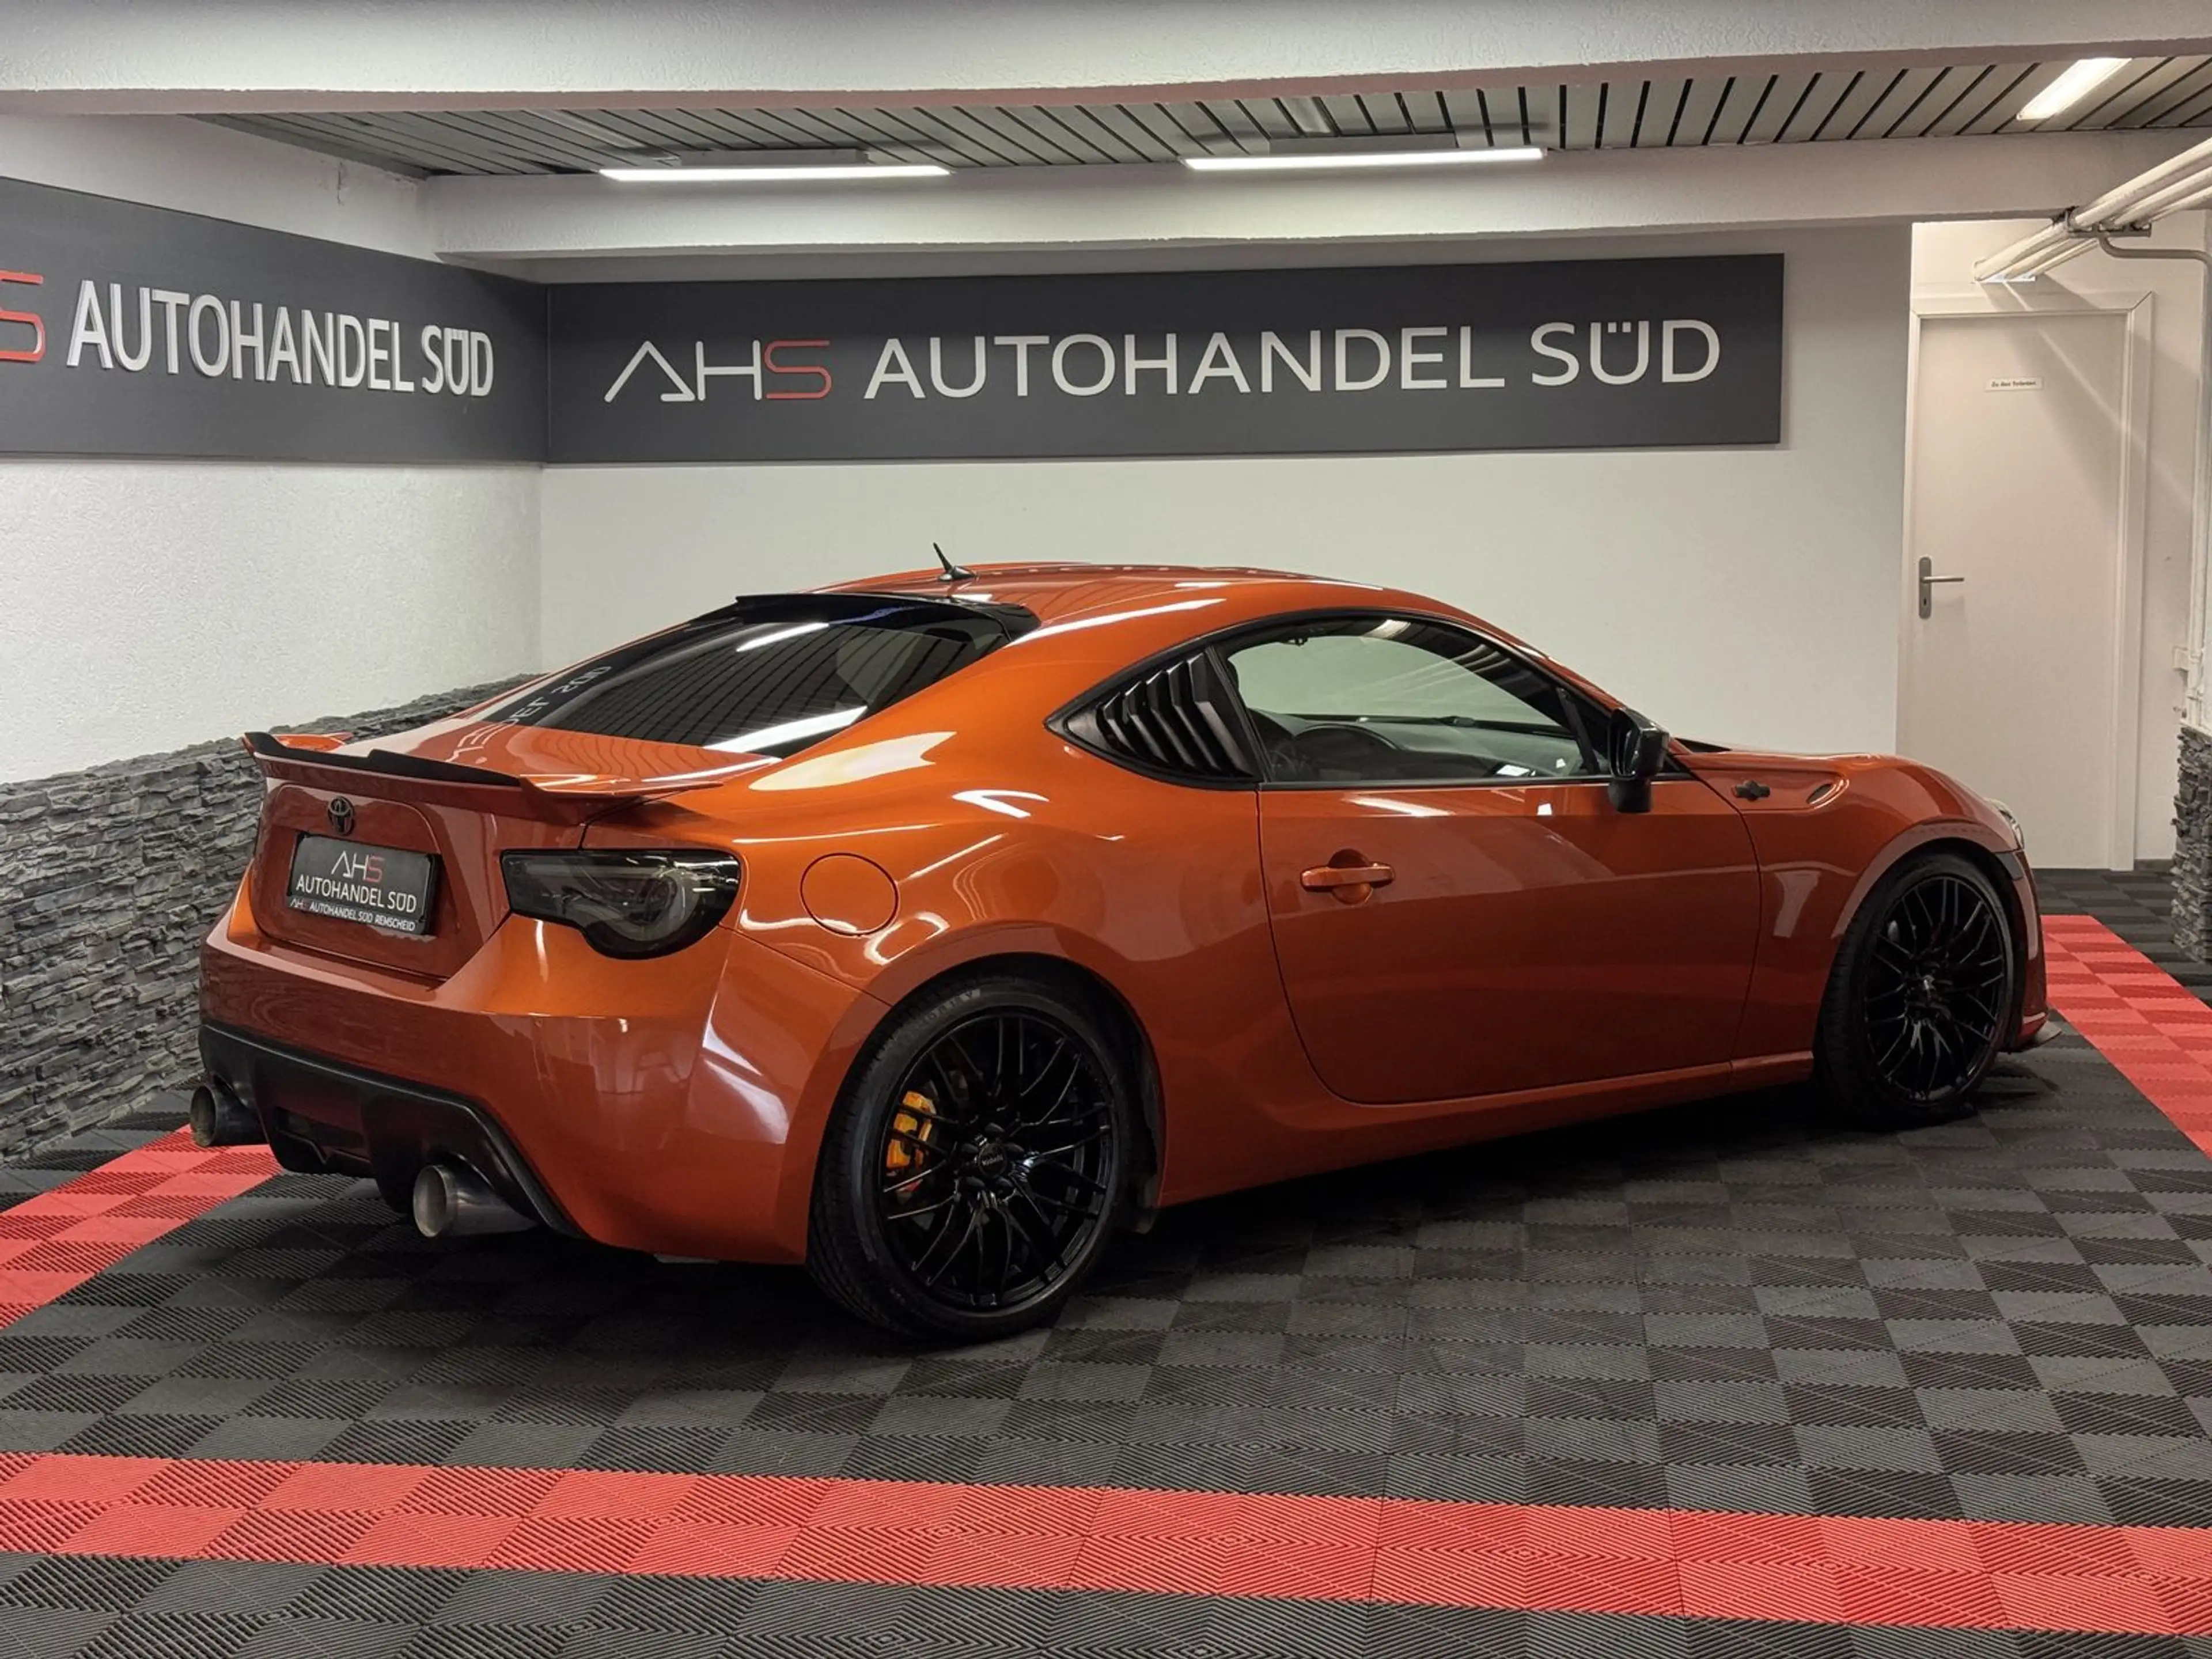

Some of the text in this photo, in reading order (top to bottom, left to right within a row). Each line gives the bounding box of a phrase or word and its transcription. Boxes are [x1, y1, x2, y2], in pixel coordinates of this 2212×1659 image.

[66, 280, 414, 393] AUTOHANDEL
[421, 325, 494, 397] SÜD
[604, 319, 1721, 402] AHS AUTOHANDEL SÜD
[331, 850, 385, 883] AHS
[296, 874, 385, 908] AUTOHANDEL
[309, 902, 357, 921] AUTOHANDEL
